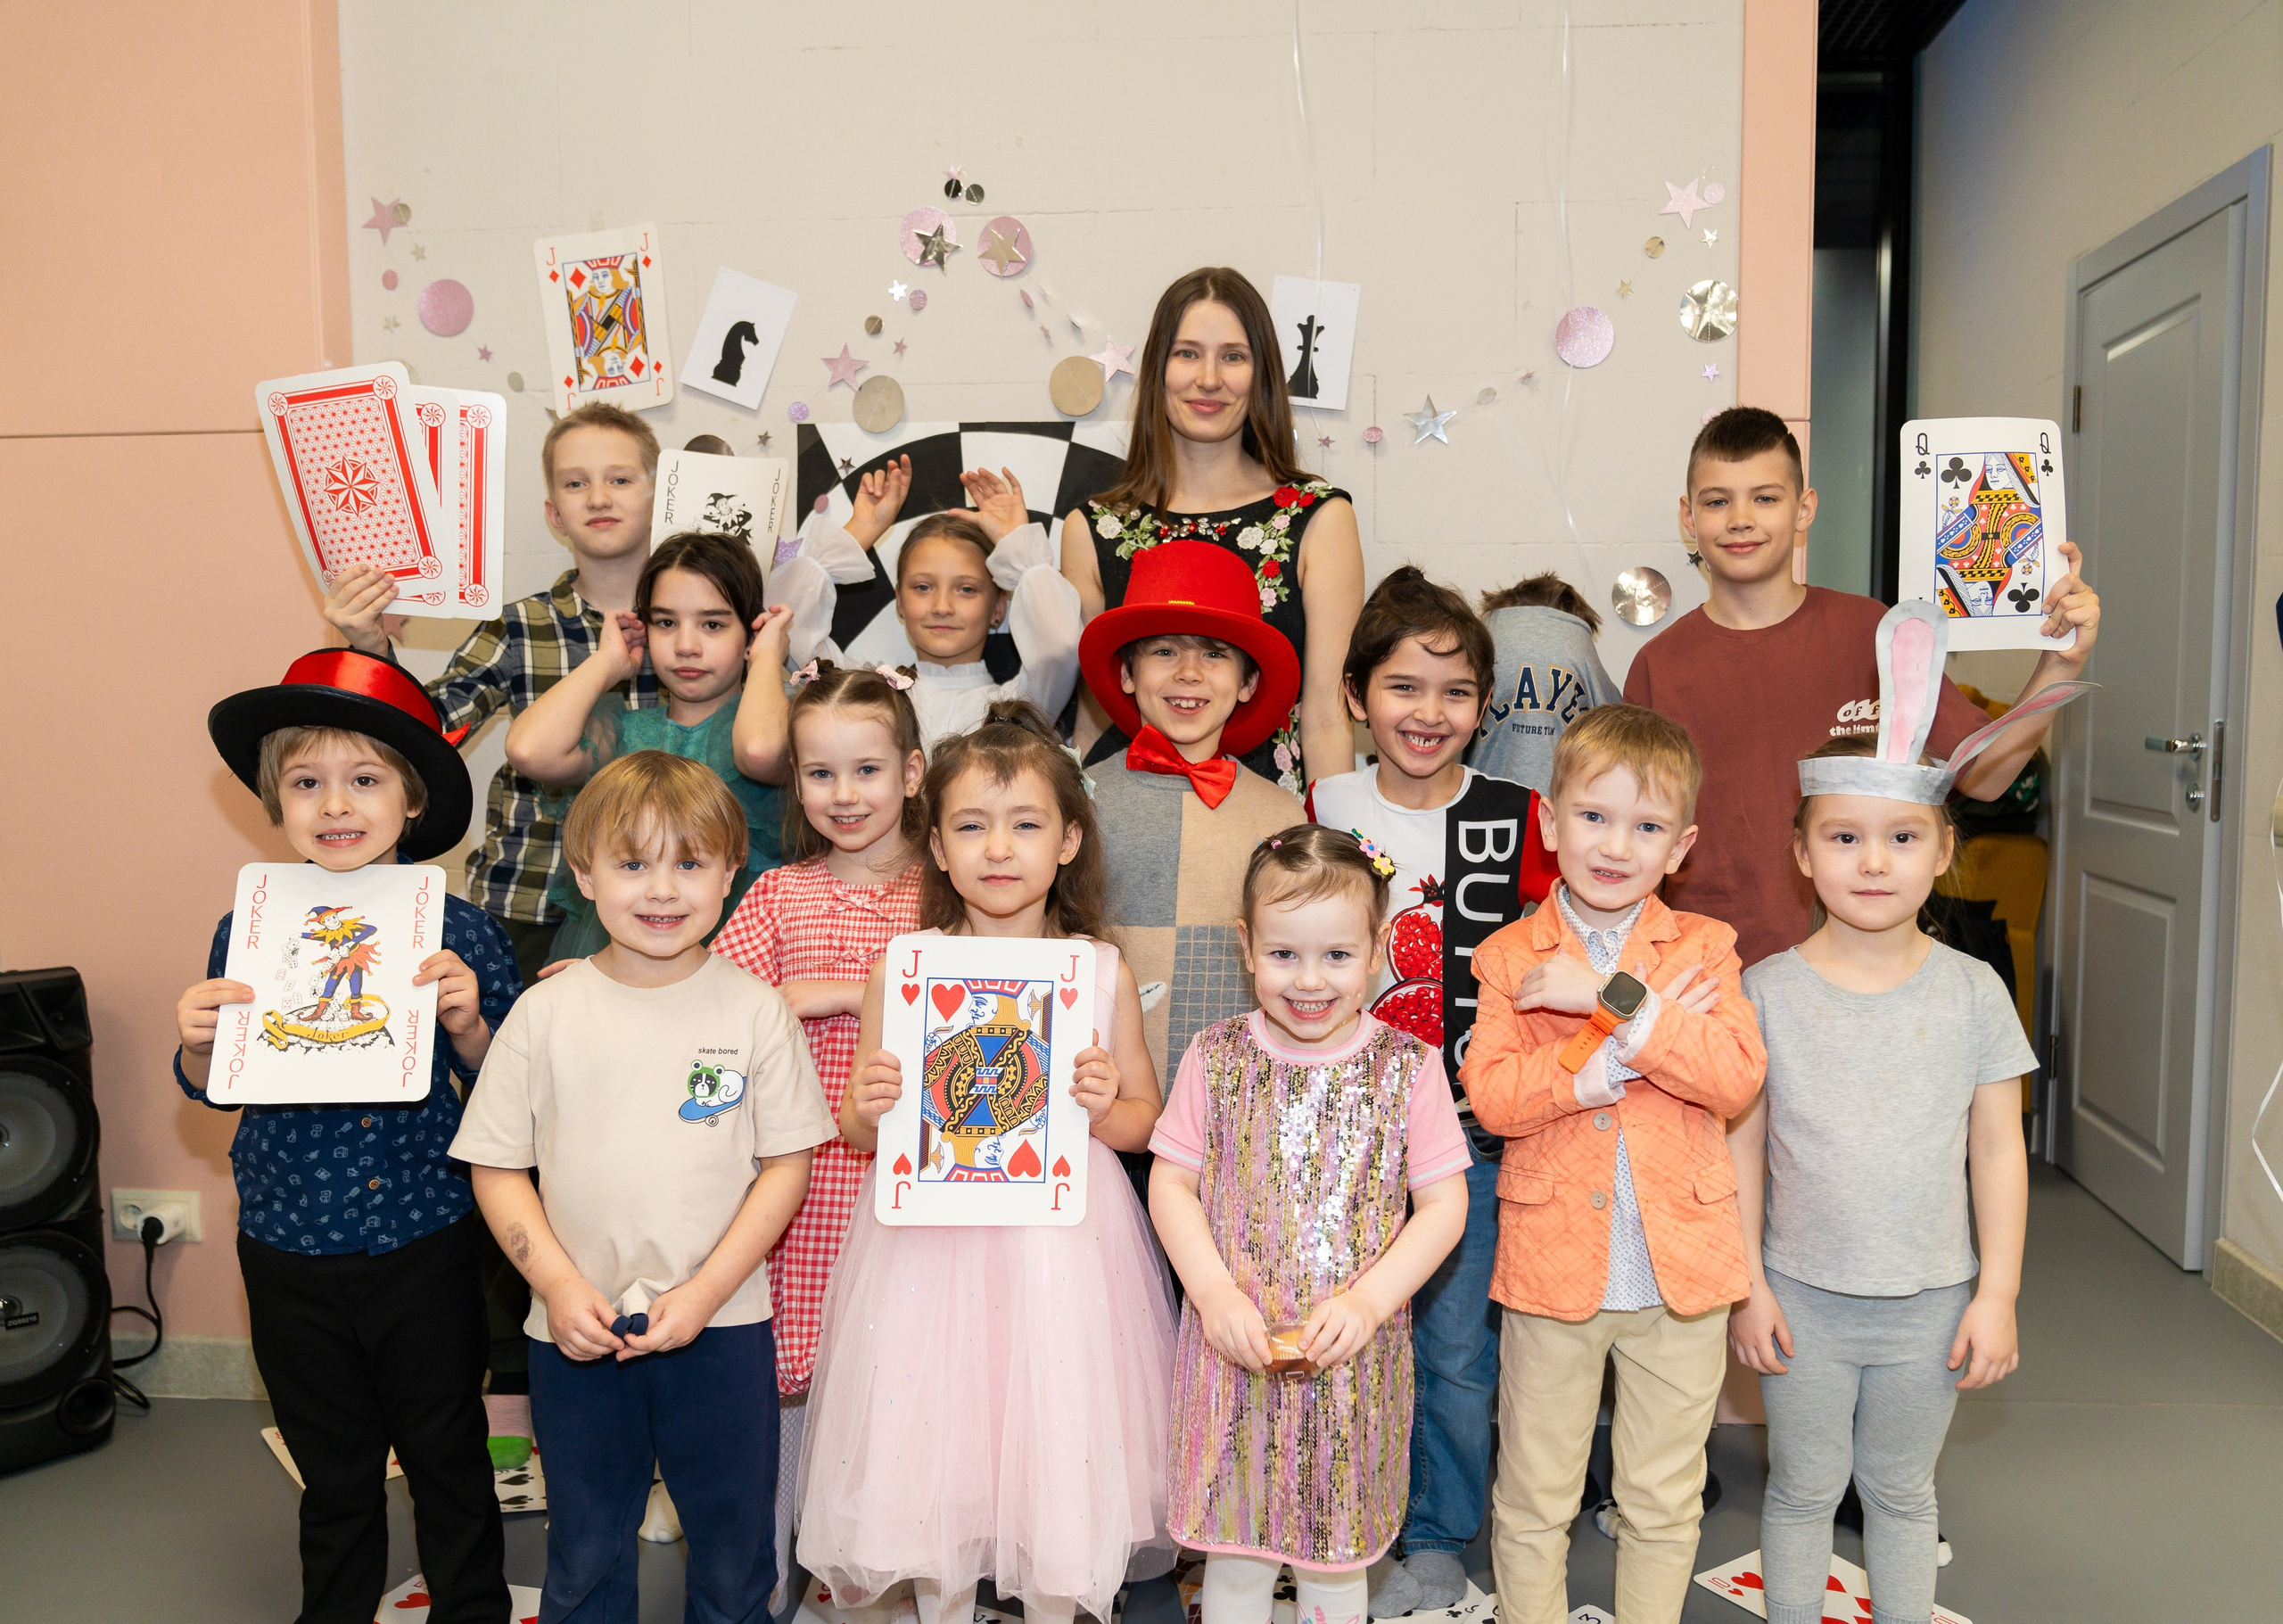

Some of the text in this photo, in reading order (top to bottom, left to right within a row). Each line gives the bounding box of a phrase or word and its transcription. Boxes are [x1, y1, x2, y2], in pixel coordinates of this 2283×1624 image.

[639, 233, 650, 252] J
[546, 247, 556, 267] J
[655, 377, 664, 397] J
[1916, 433, 1930, 456] Q
[2040, 432, 2052, 455] Q
[664, 460, 680, 524] JOKER
[767, 468, 781, 533] JOKER
[1480, 664, 1590, 739] LAYE
[1512, 723, 1543, 735] FUTURE
[1829, 726, 1852, 737] the
[247, 874, 268, 950] JOKER
[412, 876, 430, 949] JOKER
[902, 950, 922, 978] J
[1060, 955, 1080, 983] J
[307, 1027, 349, 1043] Joker
[402, 1010, 419, 1088] JOKER
[227, 1011, 251, 1090] JOKER
[698, 1047, 738, 1055] skate bored
[892, 1181, 911, 1209] J
[1051, 1183, 1070, 1211] J
